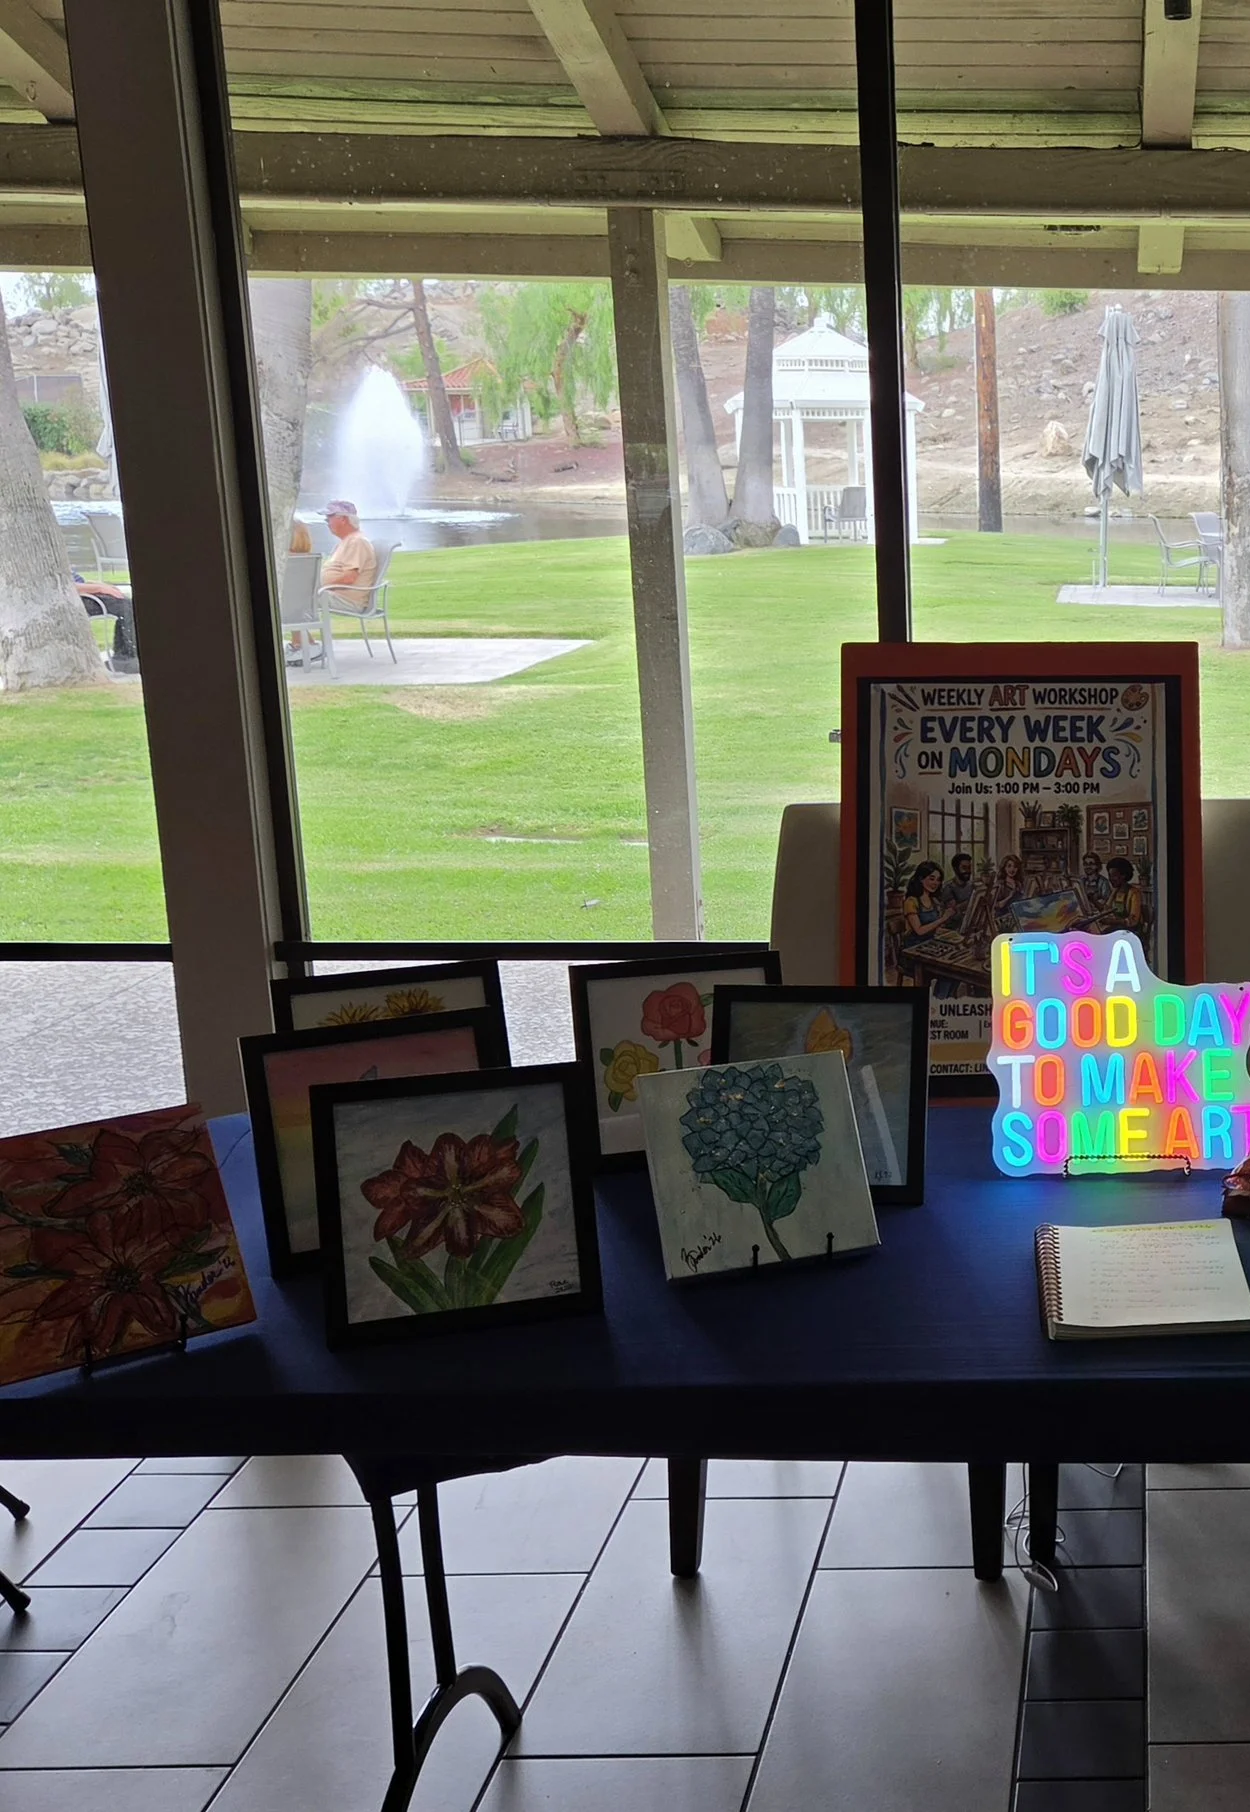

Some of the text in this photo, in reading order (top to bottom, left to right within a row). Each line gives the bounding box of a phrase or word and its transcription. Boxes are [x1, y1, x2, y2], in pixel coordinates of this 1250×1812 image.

[921, 685, 1119, 707] WEEKLY ART WORKSHOP
[920, 715, 1107, 743] EVERY WEEK
[918, 746, 1122, 779] ON MONDAYS
[948, 782, 972, 795] Join
[975, 782, 993, 794] Us:
[996, 782, 1020, 794] 1:00
[1022, 782, 1040, 794] PM
[1054, 782, 1080, 794] 3:00
[1083, 782, 1100, 794] PM
[1001, 939, 1141, 997] IT'S A
[940, 1003, 993, 1017] UNLEASH
[1002, 995, 1138, 1050] GOOD
[930, 1019, 949, 1029] NUE:
[930, 1030, 969, 1040] ST ROOM
[930, 1063, 973, 1074] CONTACT:
[997, 1047, 1235, 1109] TO MAKE
[1002, 1106, 1150, 1167] SOME
